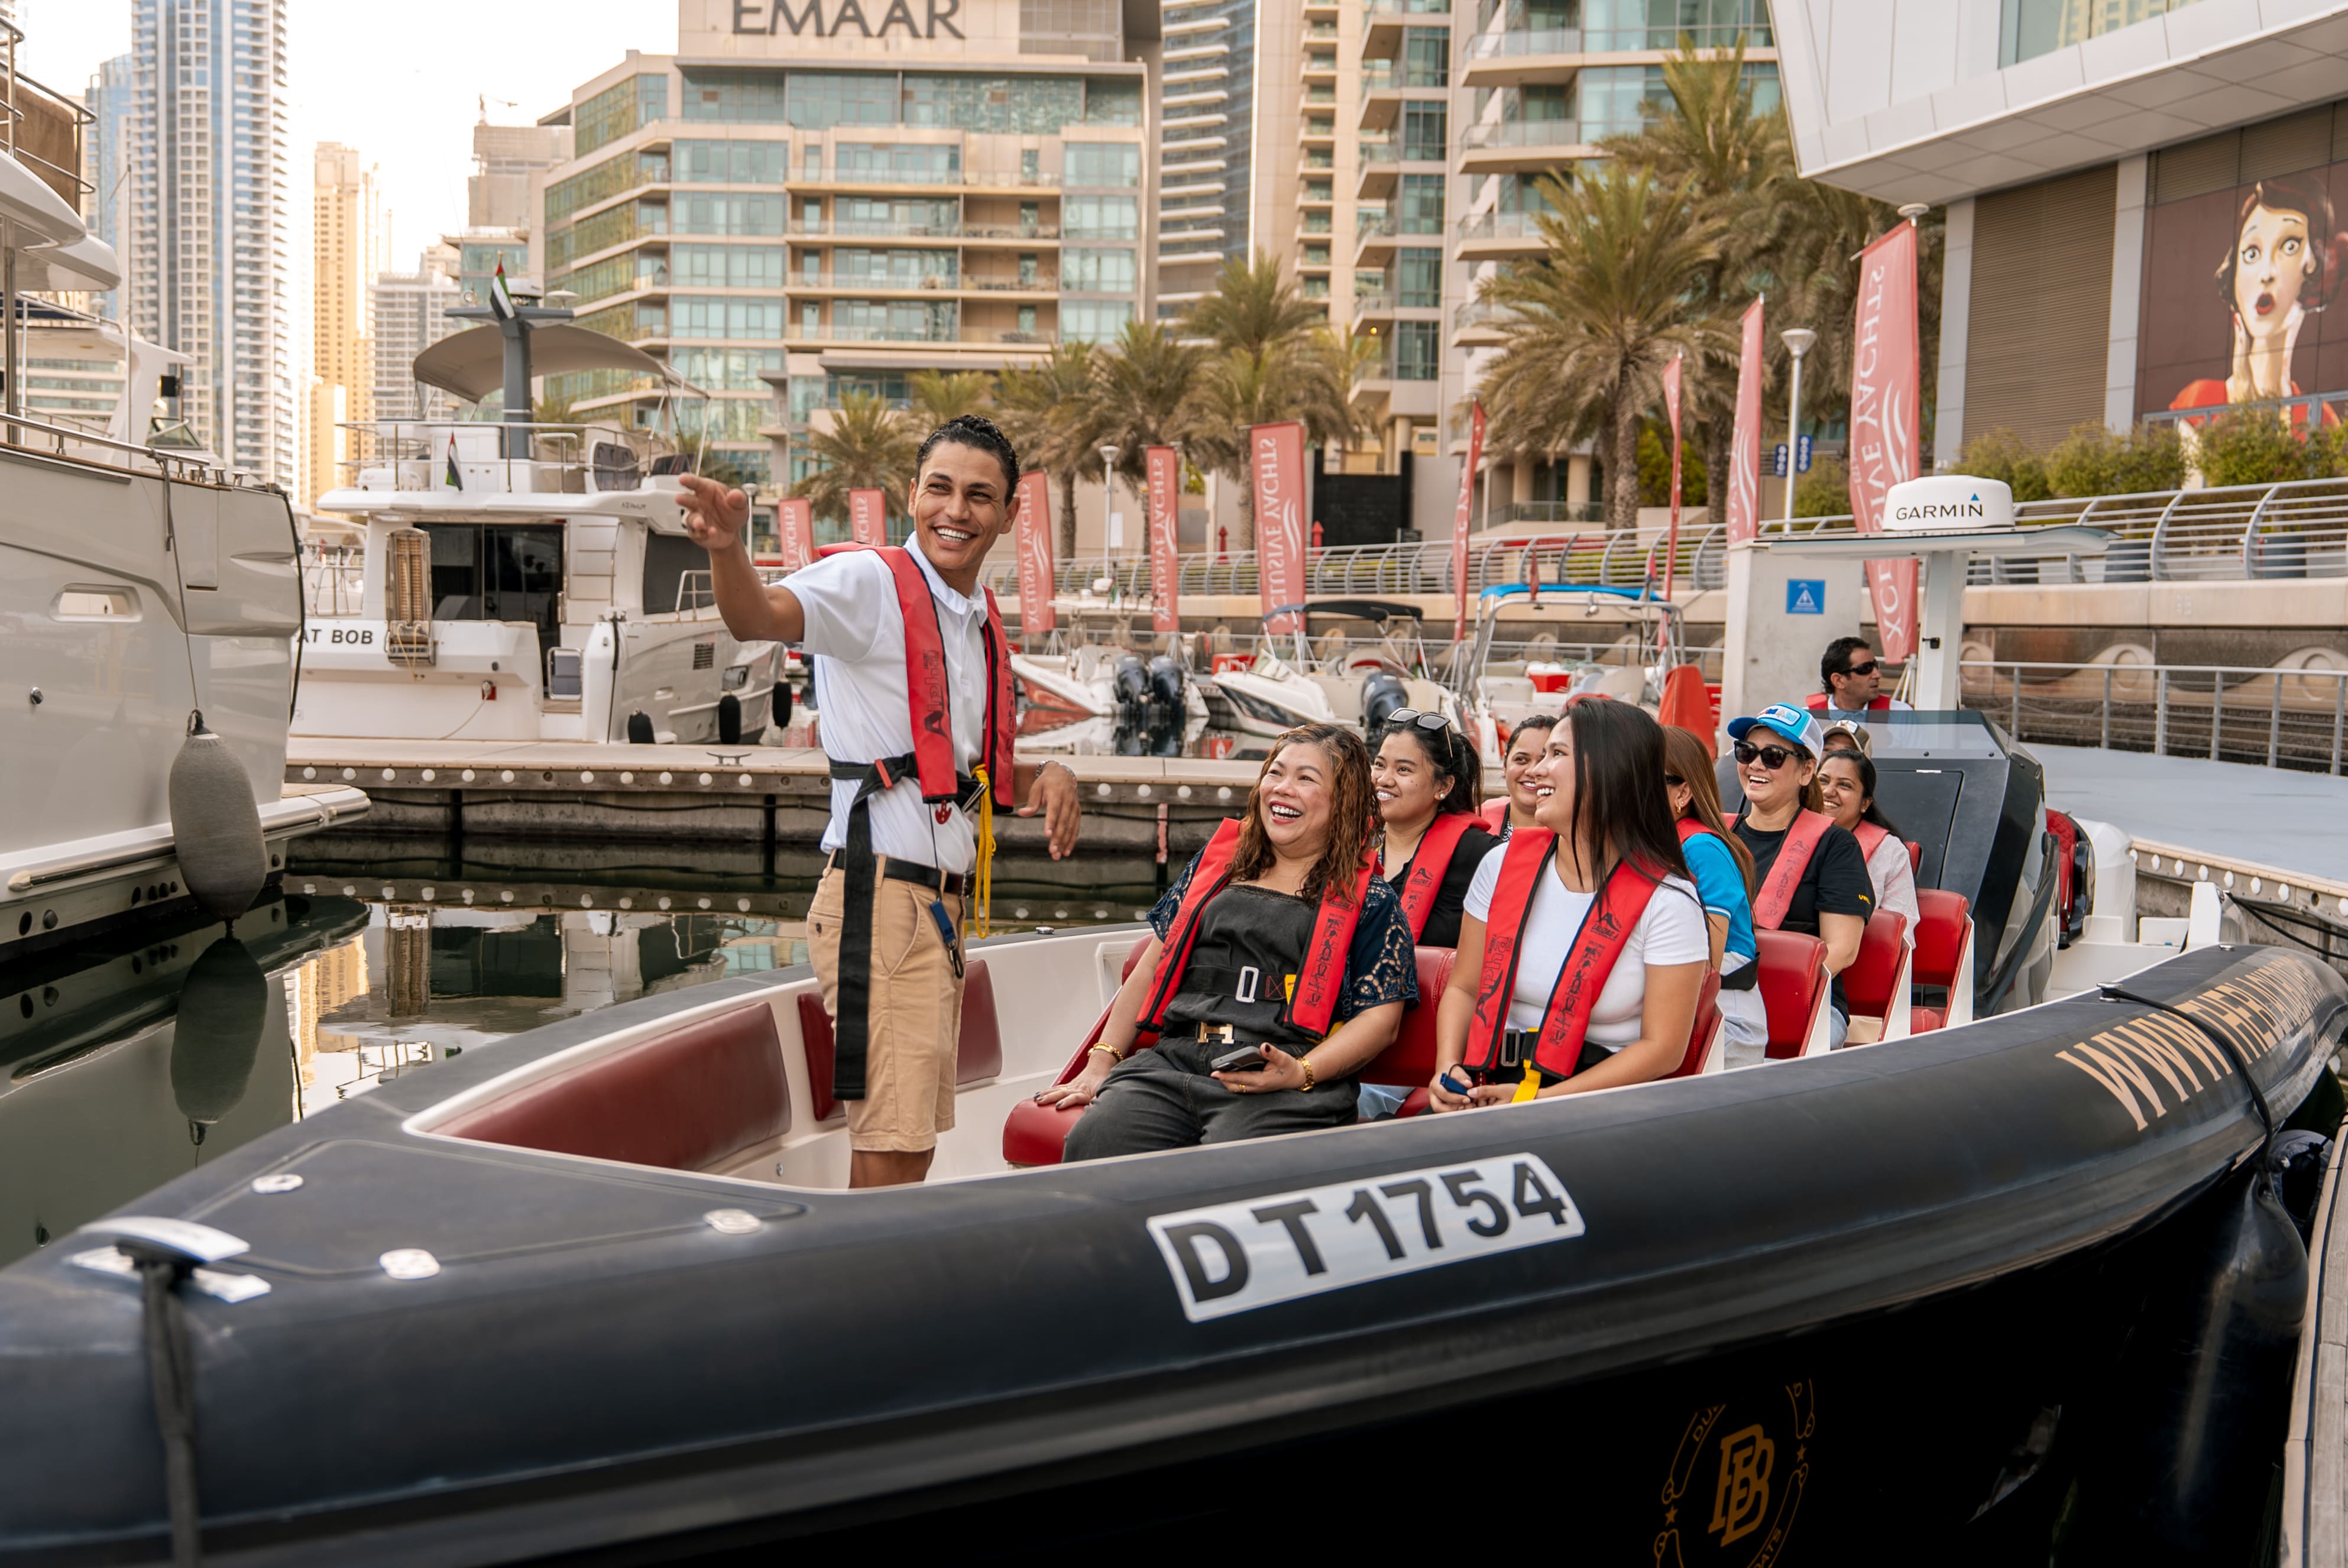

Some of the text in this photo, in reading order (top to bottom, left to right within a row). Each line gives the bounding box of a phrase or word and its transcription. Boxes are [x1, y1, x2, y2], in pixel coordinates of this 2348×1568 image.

[733, 0, 966, 39] EMAAR
[1896, 504, 1983, 520] GARMIN
[331, 630, 373, 644] BOB
[1475, 935, 1509, 1028] Alpha
[1345, 1162, 1568, 1261] 1754
